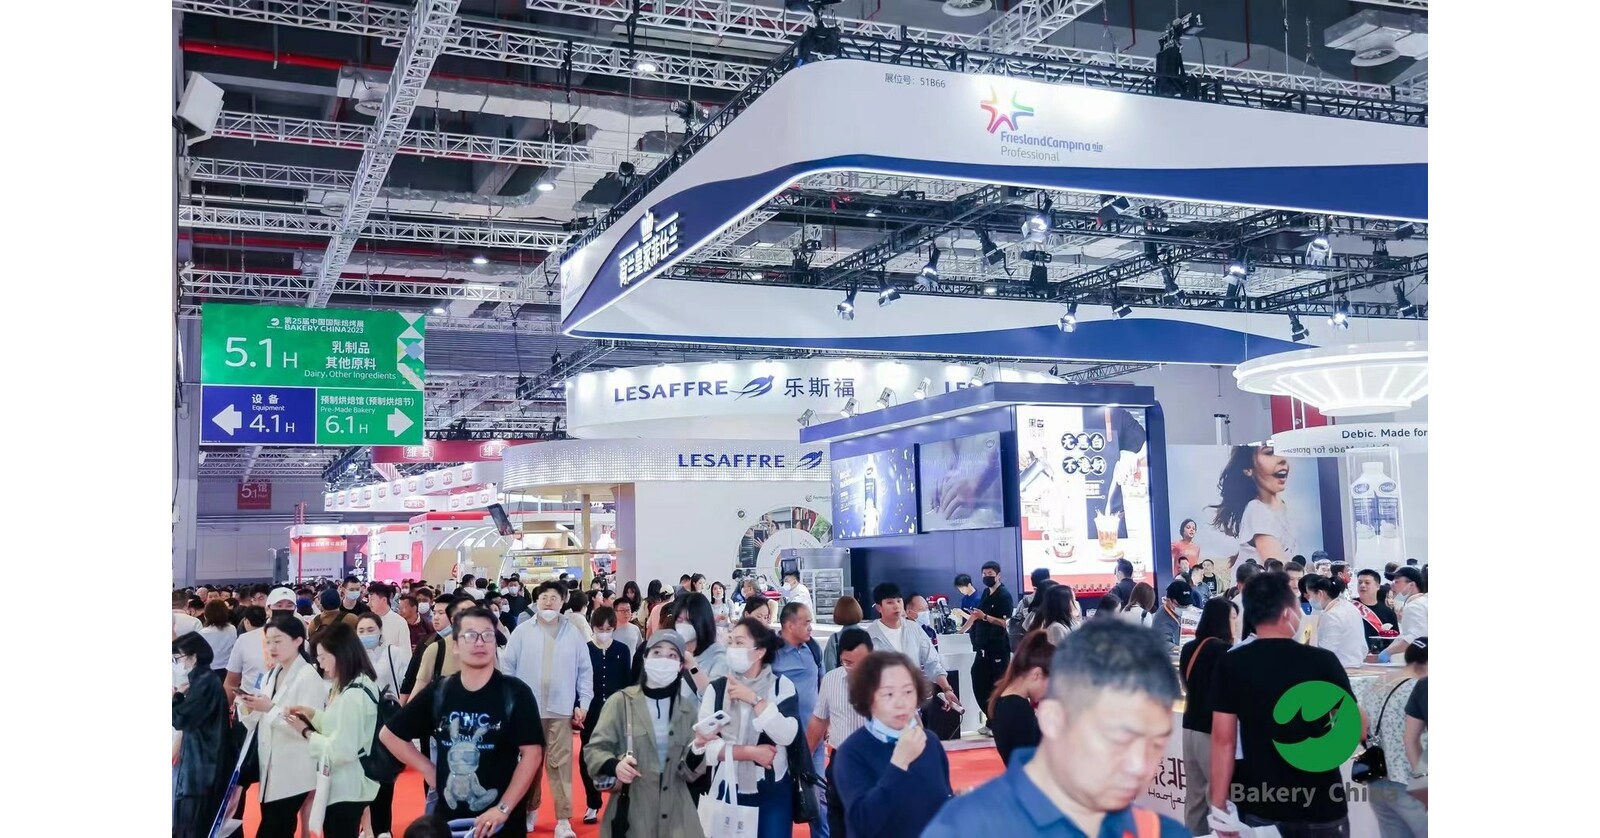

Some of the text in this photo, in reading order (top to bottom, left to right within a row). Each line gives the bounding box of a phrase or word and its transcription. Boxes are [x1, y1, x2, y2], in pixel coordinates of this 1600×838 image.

[1000, 146, 1060, 162] Professional
[225, 336, 272, 368] 5.1
[332, 341, 370, 354] 乳制品
[325, 356, 376, 370] 其他原料
[329, 370, 351, 378] Other
[353, 371, 396, 381] Ingredients
[614, 380, 729, 402] LESAFFRE
[784, 377, 855, 397] 乐斯福
[252, 405, 285, 413] Equipment
[320, 406, 376, 415] Pre-Made Bakery
[249, 414, 280, 433] 4.1
[325, 415, 354, 434] 6.1
[1341, 428, 1428, 439] Debic. Made for
[678, 453, 785, 468] LESAFFRE
